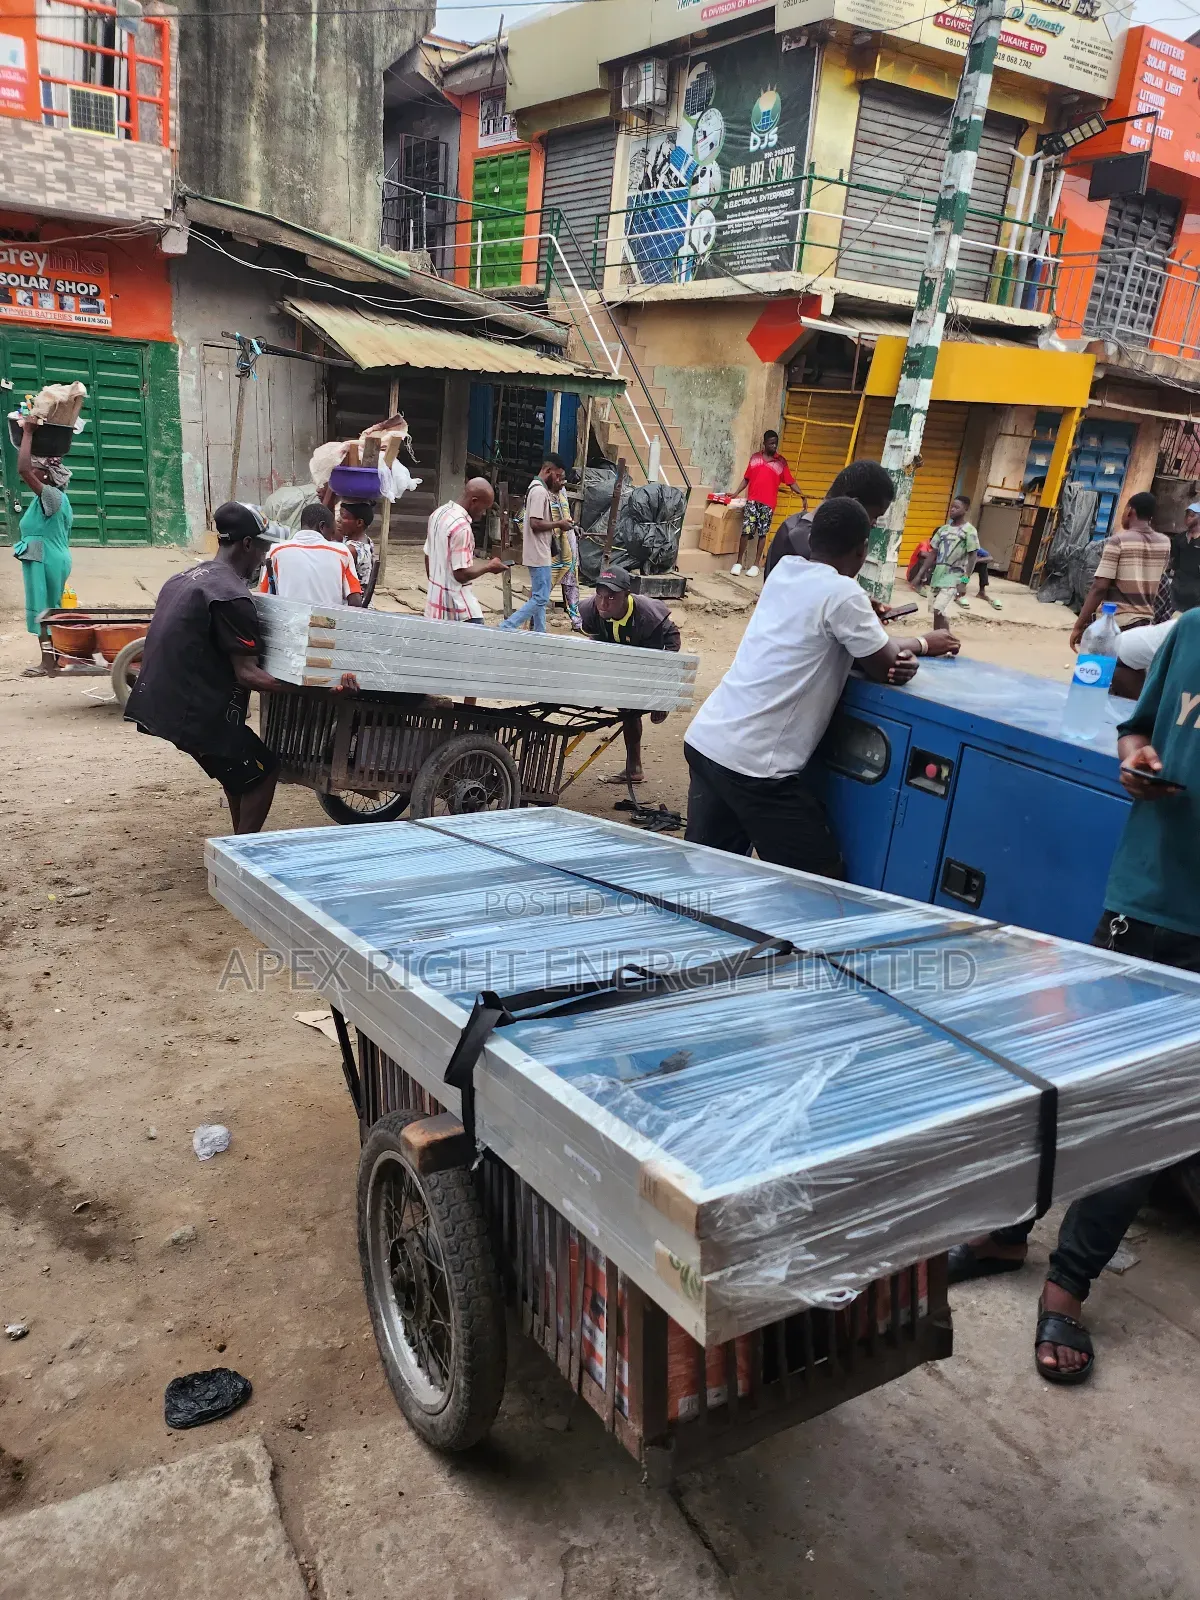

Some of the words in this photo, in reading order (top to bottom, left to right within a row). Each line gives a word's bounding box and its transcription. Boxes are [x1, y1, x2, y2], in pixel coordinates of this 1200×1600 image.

[708, 3, 736, 17] DIVISION
[937, 15, 944, 24] A
[945, 18, 973, 33] DIVISIO
[1028, 12, 1066, 35] Dynasty
[1029, 44, 1045, 55] ENT.
[1149, 37, 1185, 61] INVERTERS
[1006, 54, 1018, 64] 068
[1019, 57, 1033, 70] 2742
[1146, 54, 1167, 73] SOLAR
[1168, 64, 1187, 81] PANEL
[1142, 71, 1163, 89] SOLAR
[1165, 81, 1183, 97] LIGHT
[1139, 88, 1166, 108] LITHIUM
[750, 127, 779, 153] DJS
[1130, 134, 1149, 151] MPPT
[729, 195, 759, 209] ELECTRICAL
[760, 188, 796, 202] ENTERPRISES
[0, 272, 49, 290] SOLAR
[56, 279, 98, 296] SHOP
[35, 310, 73, 321] BATTERIES
[1079, 667, 1097, 676] eva
[1175, 692, 1200, 729] Y
